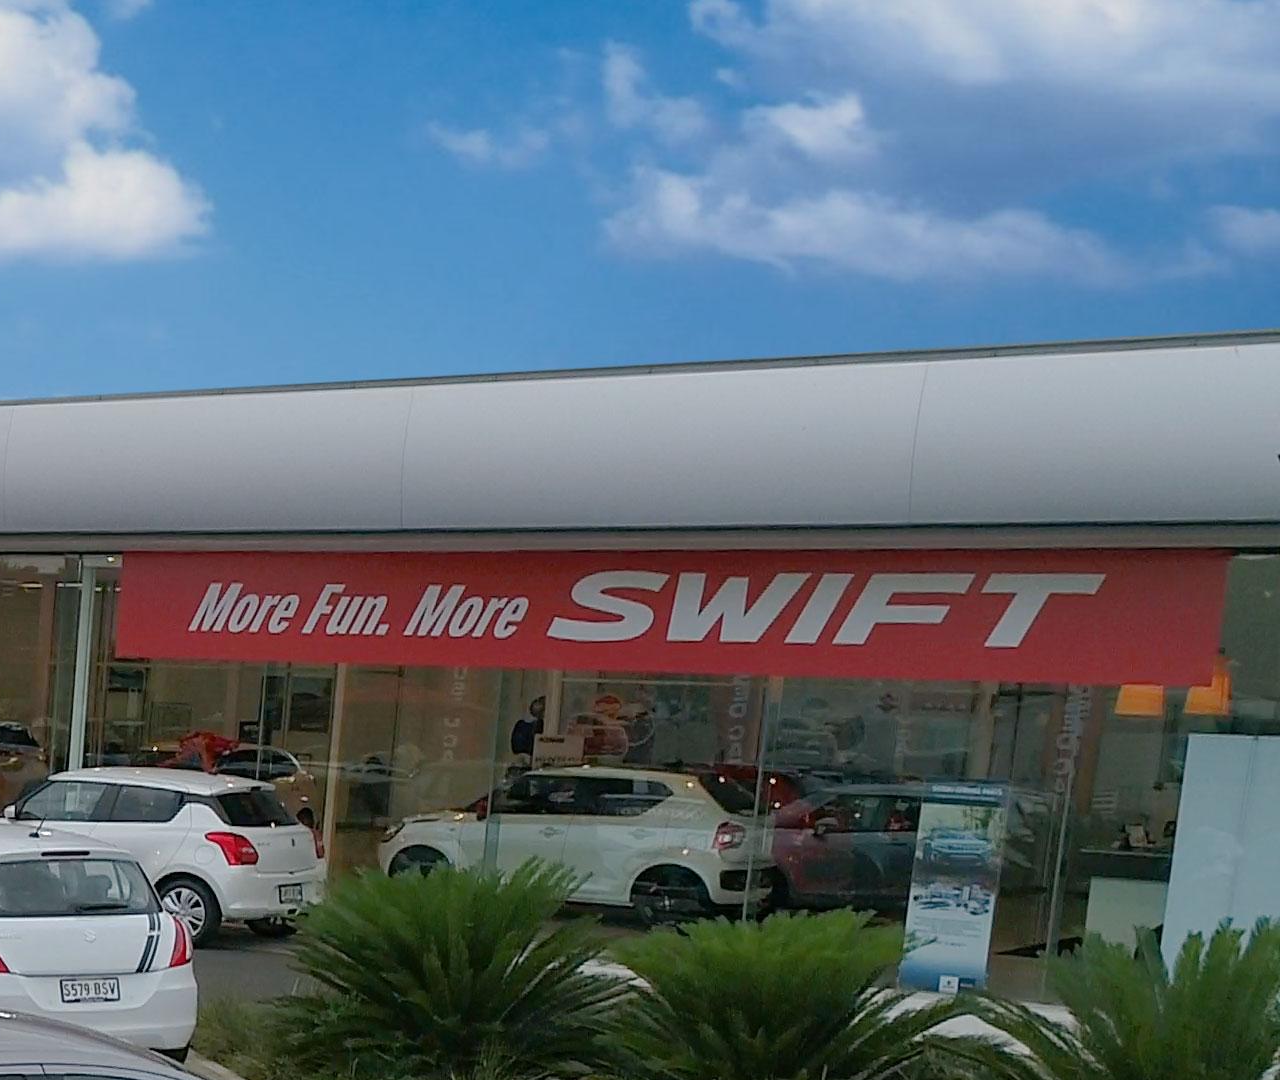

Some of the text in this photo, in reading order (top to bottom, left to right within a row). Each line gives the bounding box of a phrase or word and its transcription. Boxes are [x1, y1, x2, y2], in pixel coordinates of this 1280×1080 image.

[188, 569, 1107, 648] More Fun. More SWIFT
